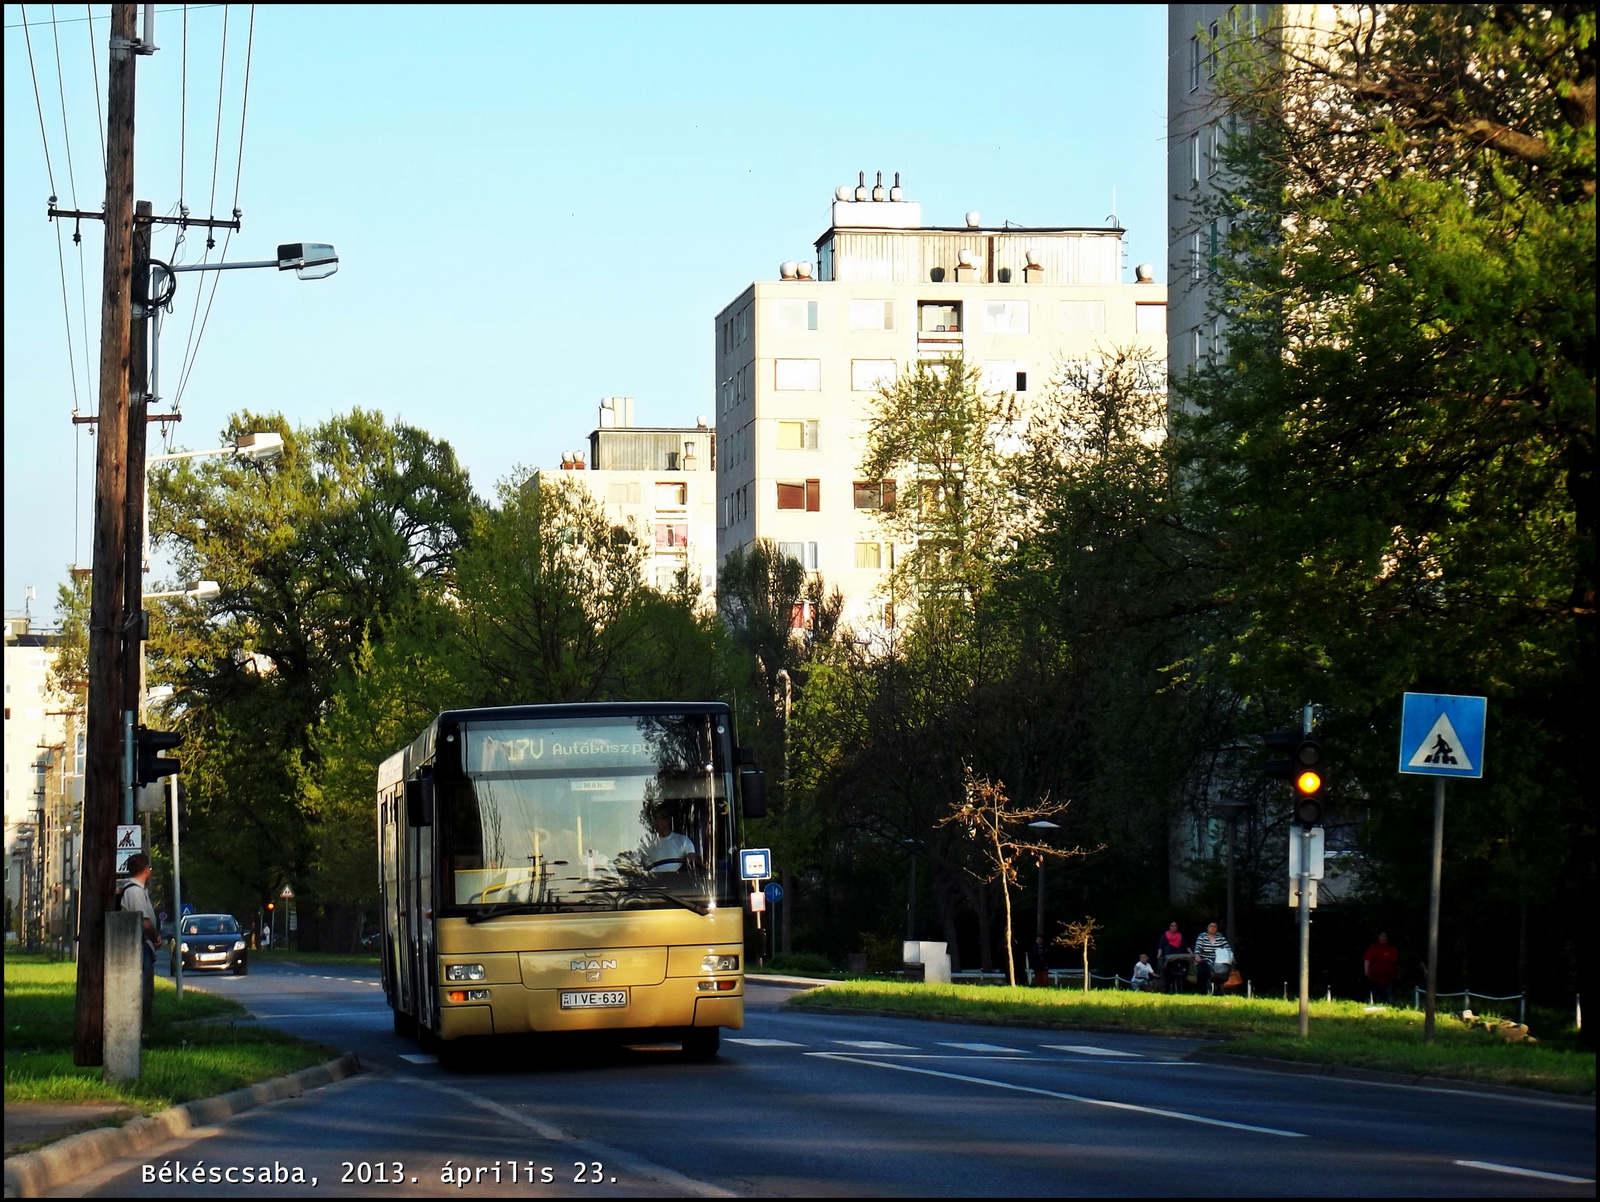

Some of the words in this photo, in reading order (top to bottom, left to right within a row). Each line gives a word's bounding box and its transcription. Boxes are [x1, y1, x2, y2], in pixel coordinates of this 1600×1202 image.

[552, 743, 630, 756] Autóbusz
[571, 959, 617, 971] MAN
[574, 992, 625, 1005] IVE-632
